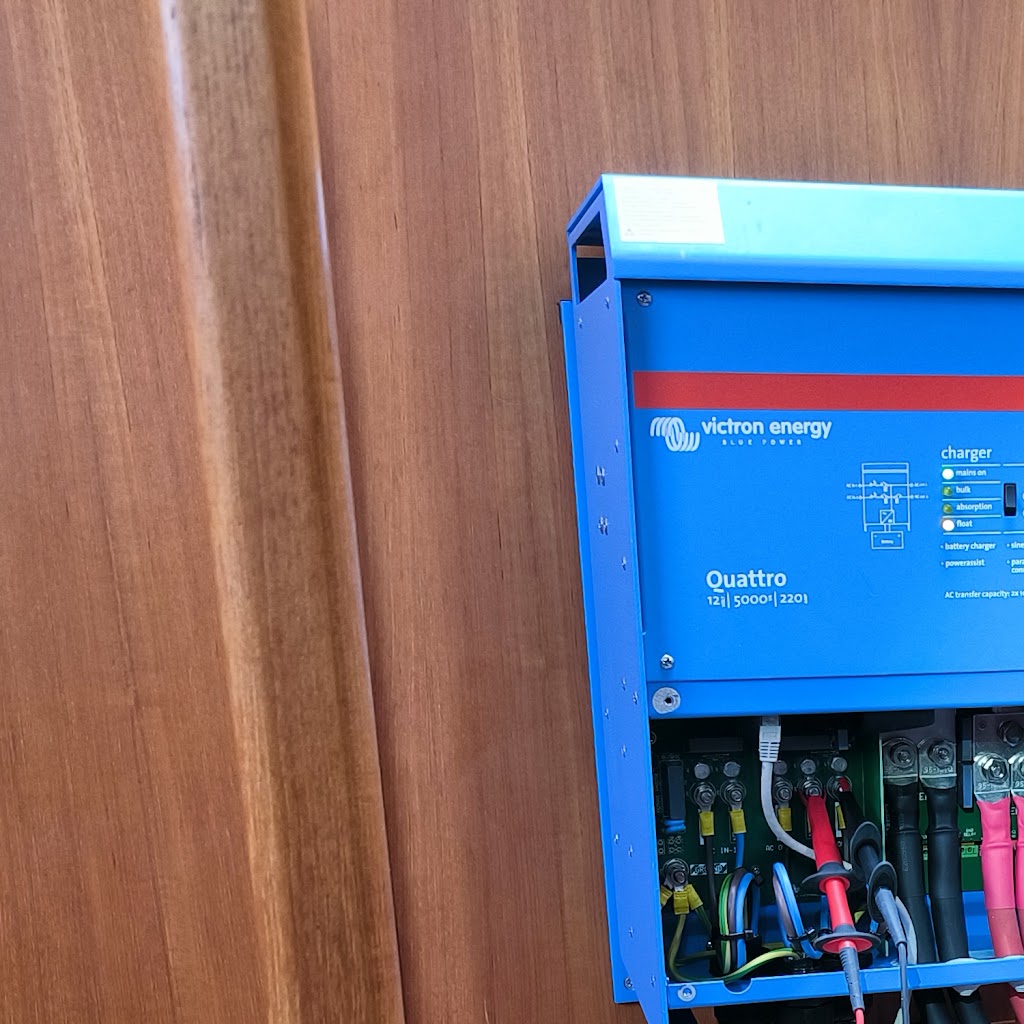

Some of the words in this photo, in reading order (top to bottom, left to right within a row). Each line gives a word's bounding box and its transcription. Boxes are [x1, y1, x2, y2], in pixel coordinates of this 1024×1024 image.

[701, 416, 764, 435] victron
[769, 421, 832, 439] energy
[941, 445, 992, 462] charger
[955, 468, 976, 477] mains
[977, 469, 987, 477] on
[956, 486, 971, 494] bulk
[956, 502, 992, 512] absorption
[956, 519, 973, 528] float
[945, 542, 970, 551] battery
[970, 542, 996, 551] charger
[945, 559, 985, 568] powerassist
[706, 569, 787, 593] Quattro
[944, 591, 954, 599] AC
[955, 590, 981, 599] transfer
